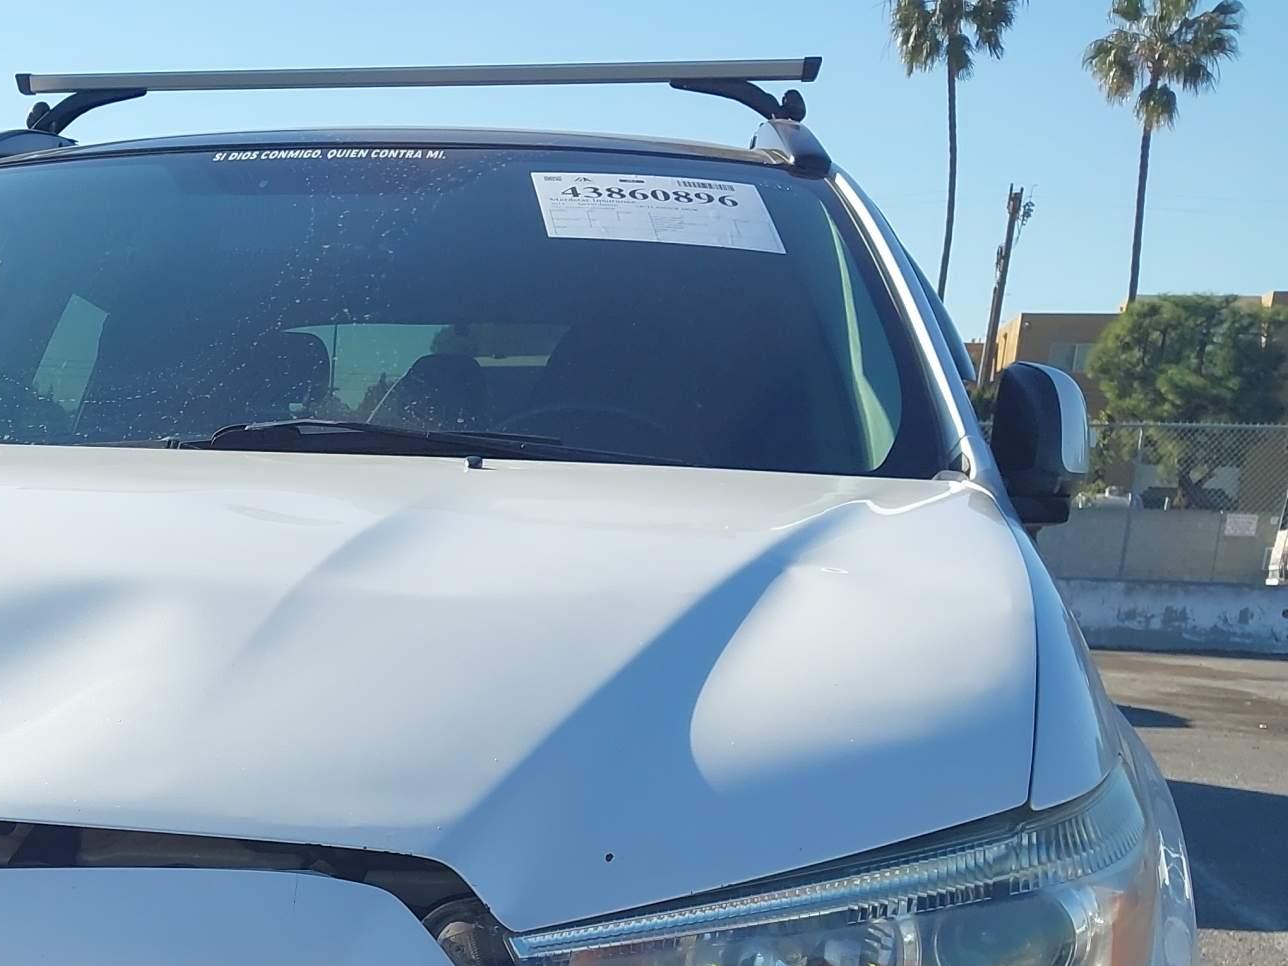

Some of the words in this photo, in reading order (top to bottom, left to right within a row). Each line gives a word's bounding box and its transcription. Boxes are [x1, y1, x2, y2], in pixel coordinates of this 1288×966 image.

[213, 152, 226, 161] SI
[228, 151, 259, 161] DIOS
[327, 149, 368, 160] QUIEN
[371, 149, 423, 160] CONTRA
[561, 185, 739, 208] 43860896
